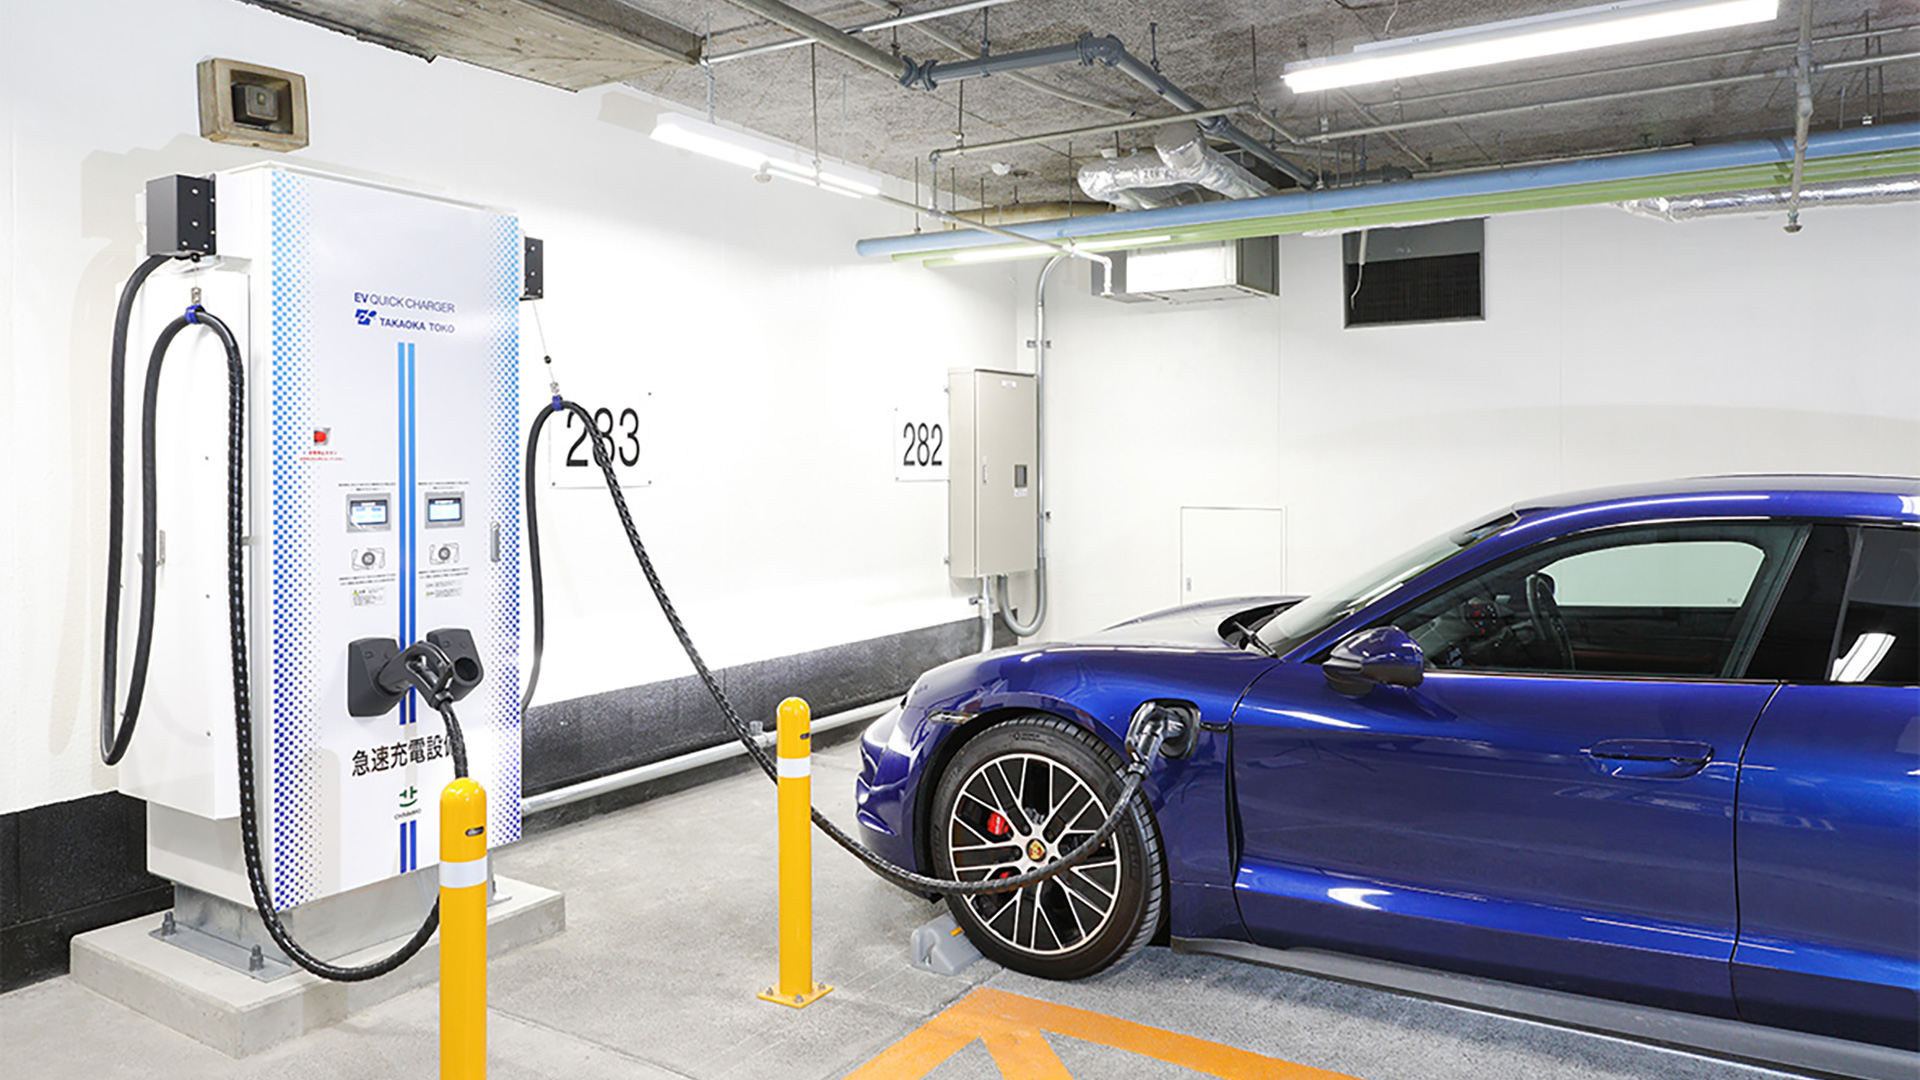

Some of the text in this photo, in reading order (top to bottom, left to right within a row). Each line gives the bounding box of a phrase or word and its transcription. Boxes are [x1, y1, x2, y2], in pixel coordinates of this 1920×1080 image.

[354, 291, 456, 313] EV QUICK CHARGER
[380, 317, 456, 334] TAKAOKA TOKO
[566, 407, 640, 467] 283
[903, 421, 943, 467] 282
